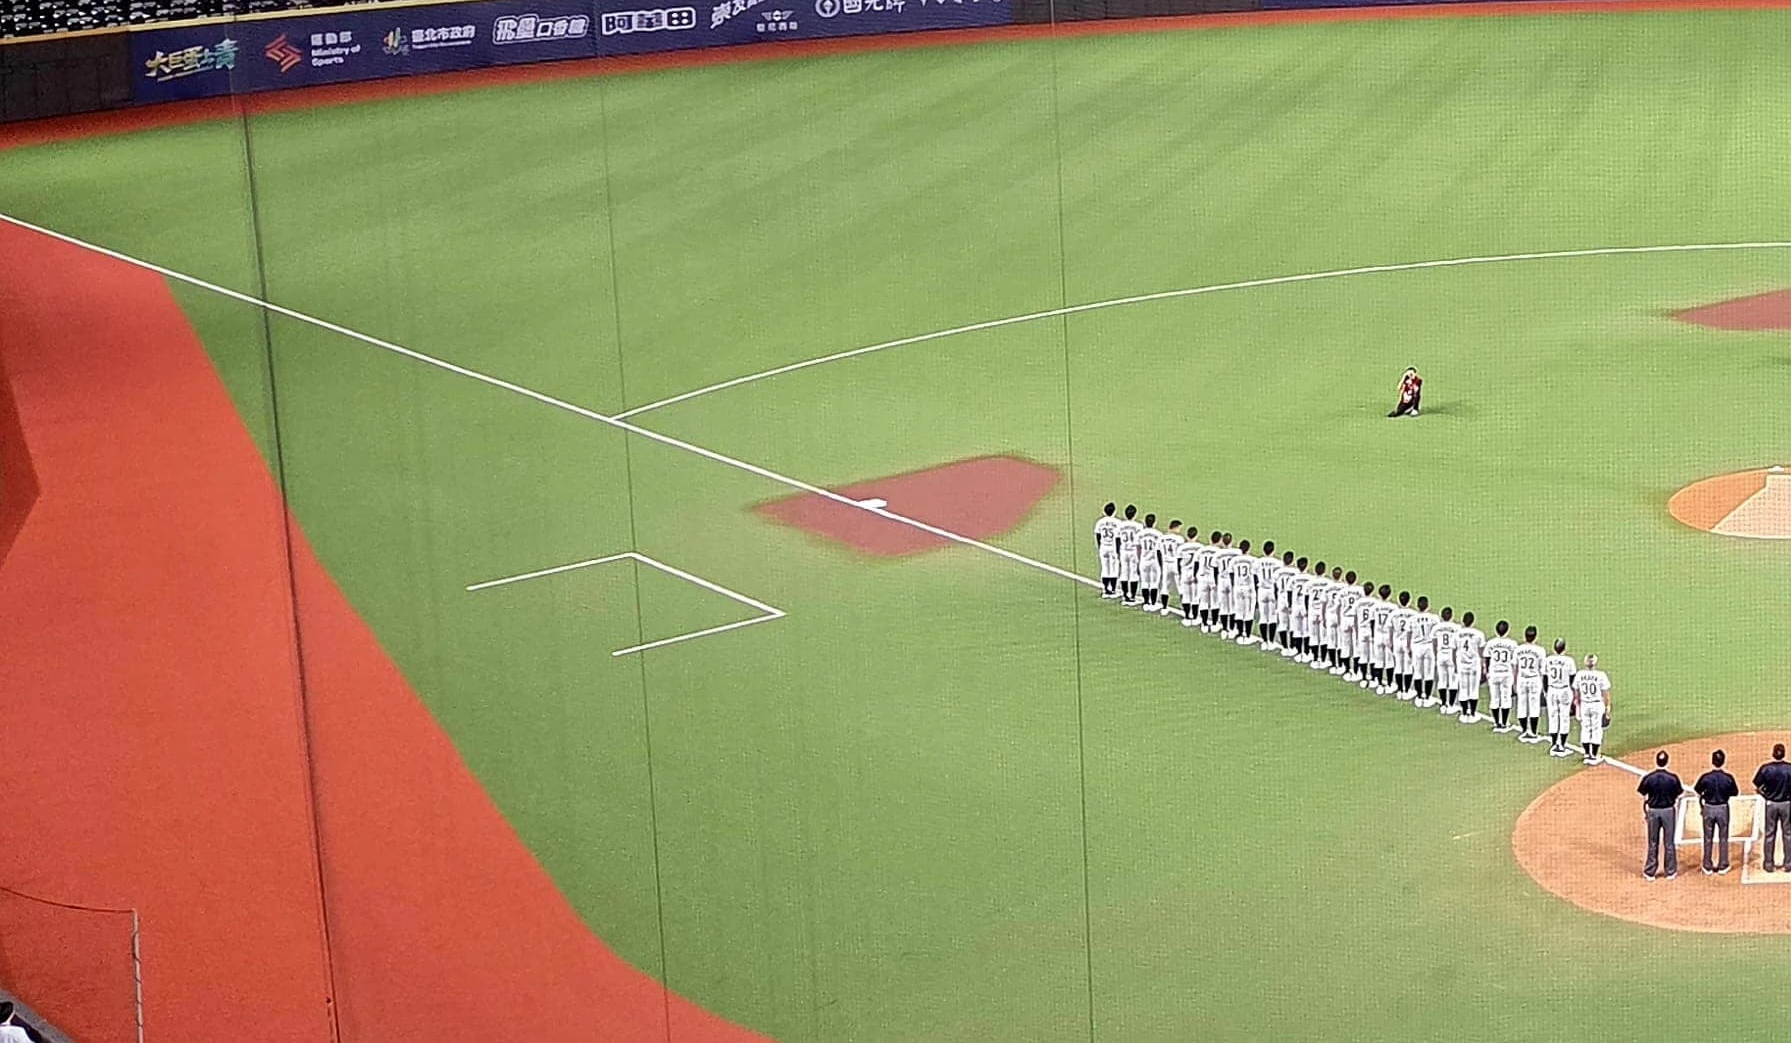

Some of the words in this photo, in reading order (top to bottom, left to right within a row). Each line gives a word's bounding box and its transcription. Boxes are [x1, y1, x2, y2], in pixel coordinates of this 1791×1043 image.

[1442, 633, 1449, 645] 8
[1493, 650, 1508, 663] 33
[1519, 656, 1535, 669] 32
[1581, 682, 1597, 696] 30
